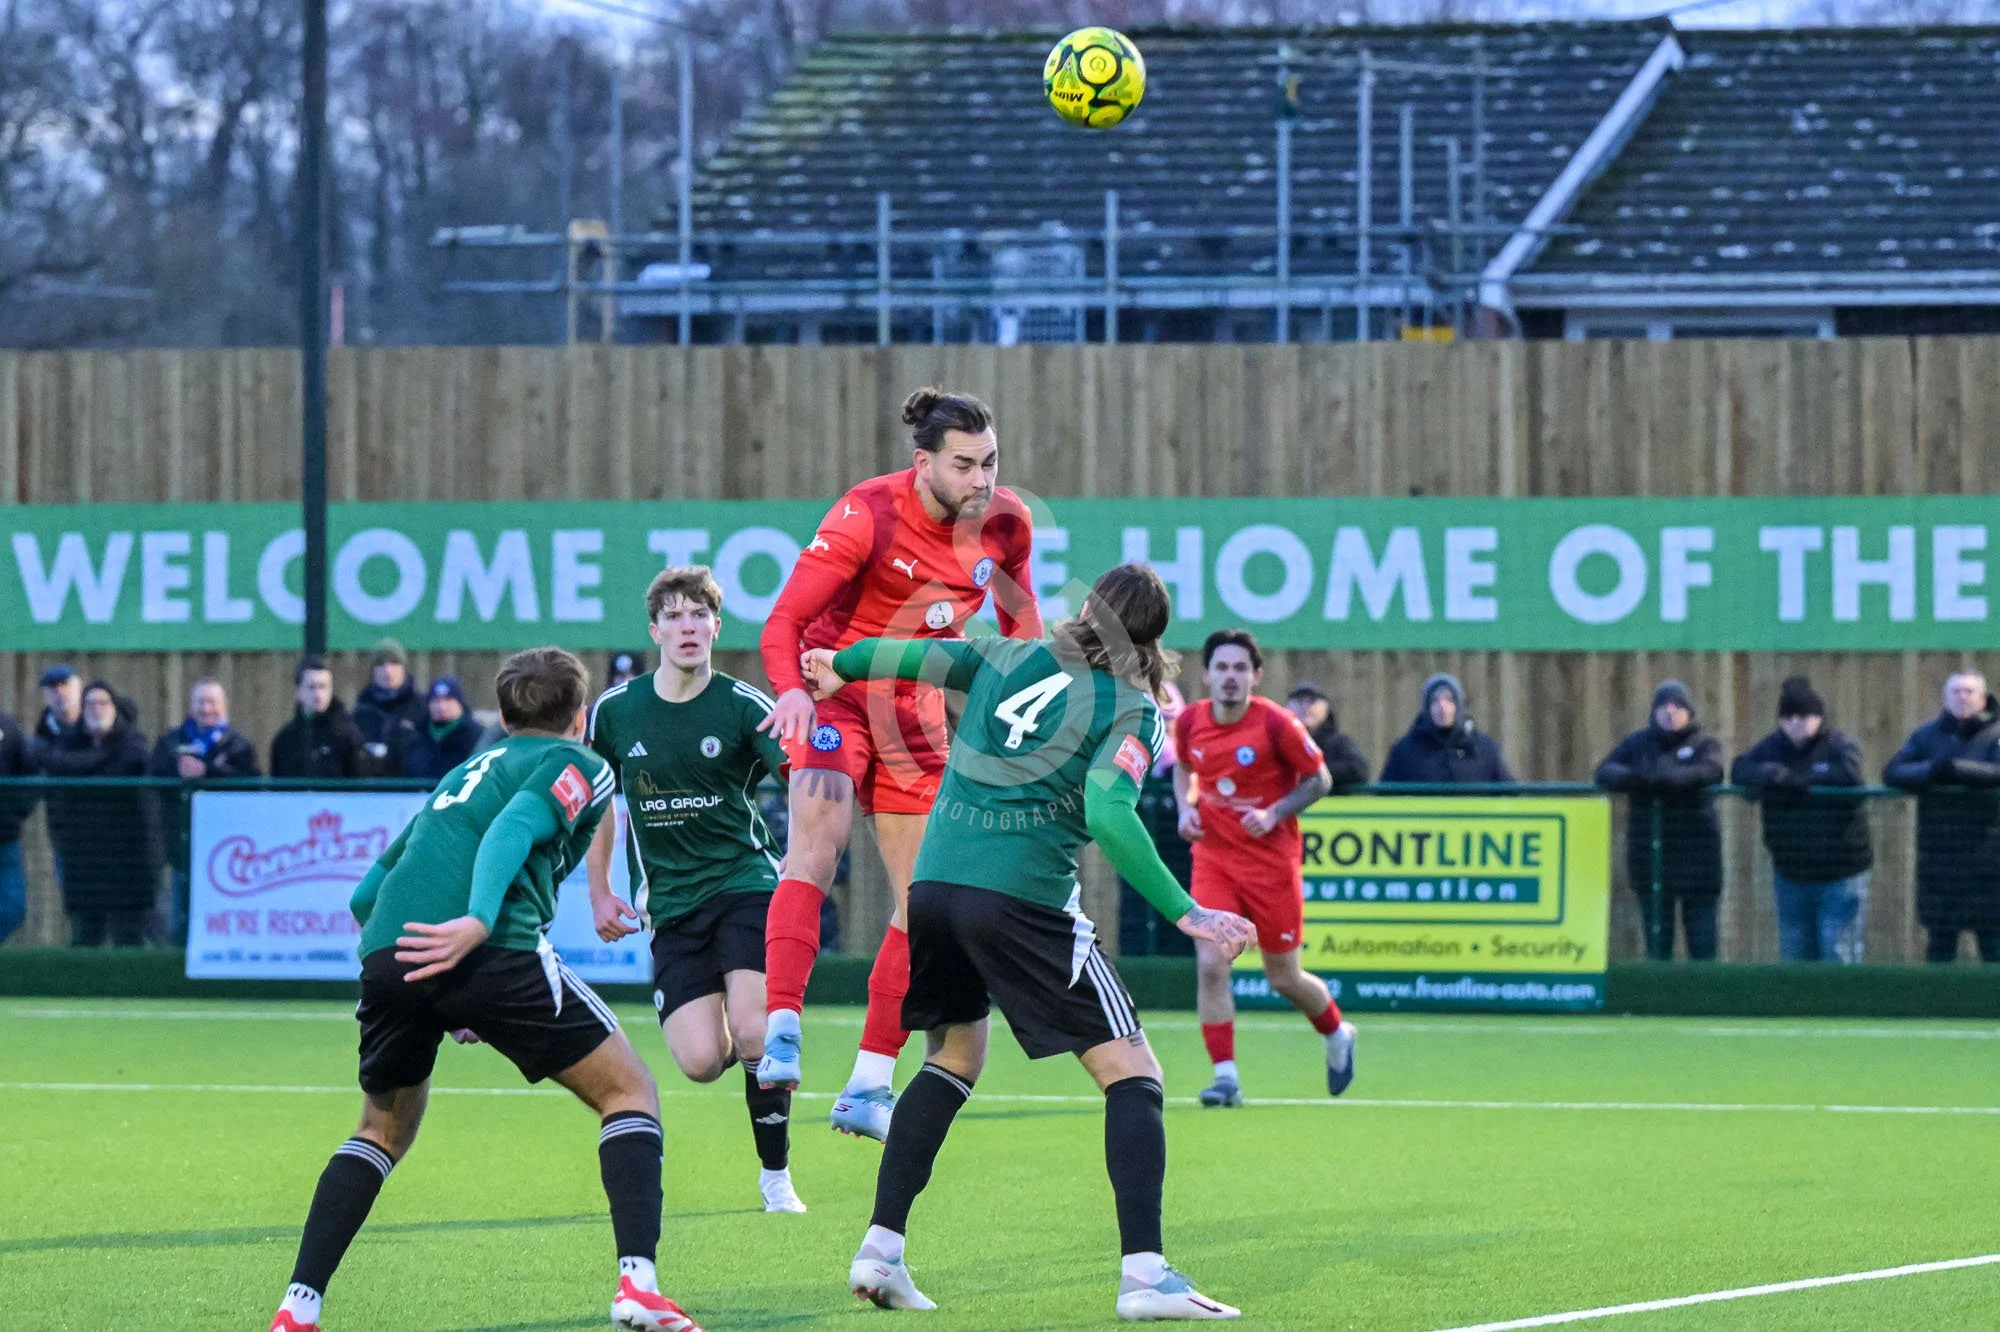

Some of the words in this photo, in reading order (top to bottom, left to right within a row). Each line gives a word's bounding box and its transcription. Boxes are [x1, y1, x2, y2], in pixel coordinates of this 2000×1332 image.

[11, 528, 605, 624] WELCOME
[1122, 524, 1497, 623] HOME
[1549, 524, 1714, 624] OF
[1759, 525, 1987, 622] THE
[994, 671, 1074, 749] 4
[432, 747, 508, 810] 3
[640, 799, 667, 812] LRG
[1301, 830, 1542, 868] RONTLINE
[1319, 934, 1462, 957] Automation
[1491, 935, 1588, 963] Security
